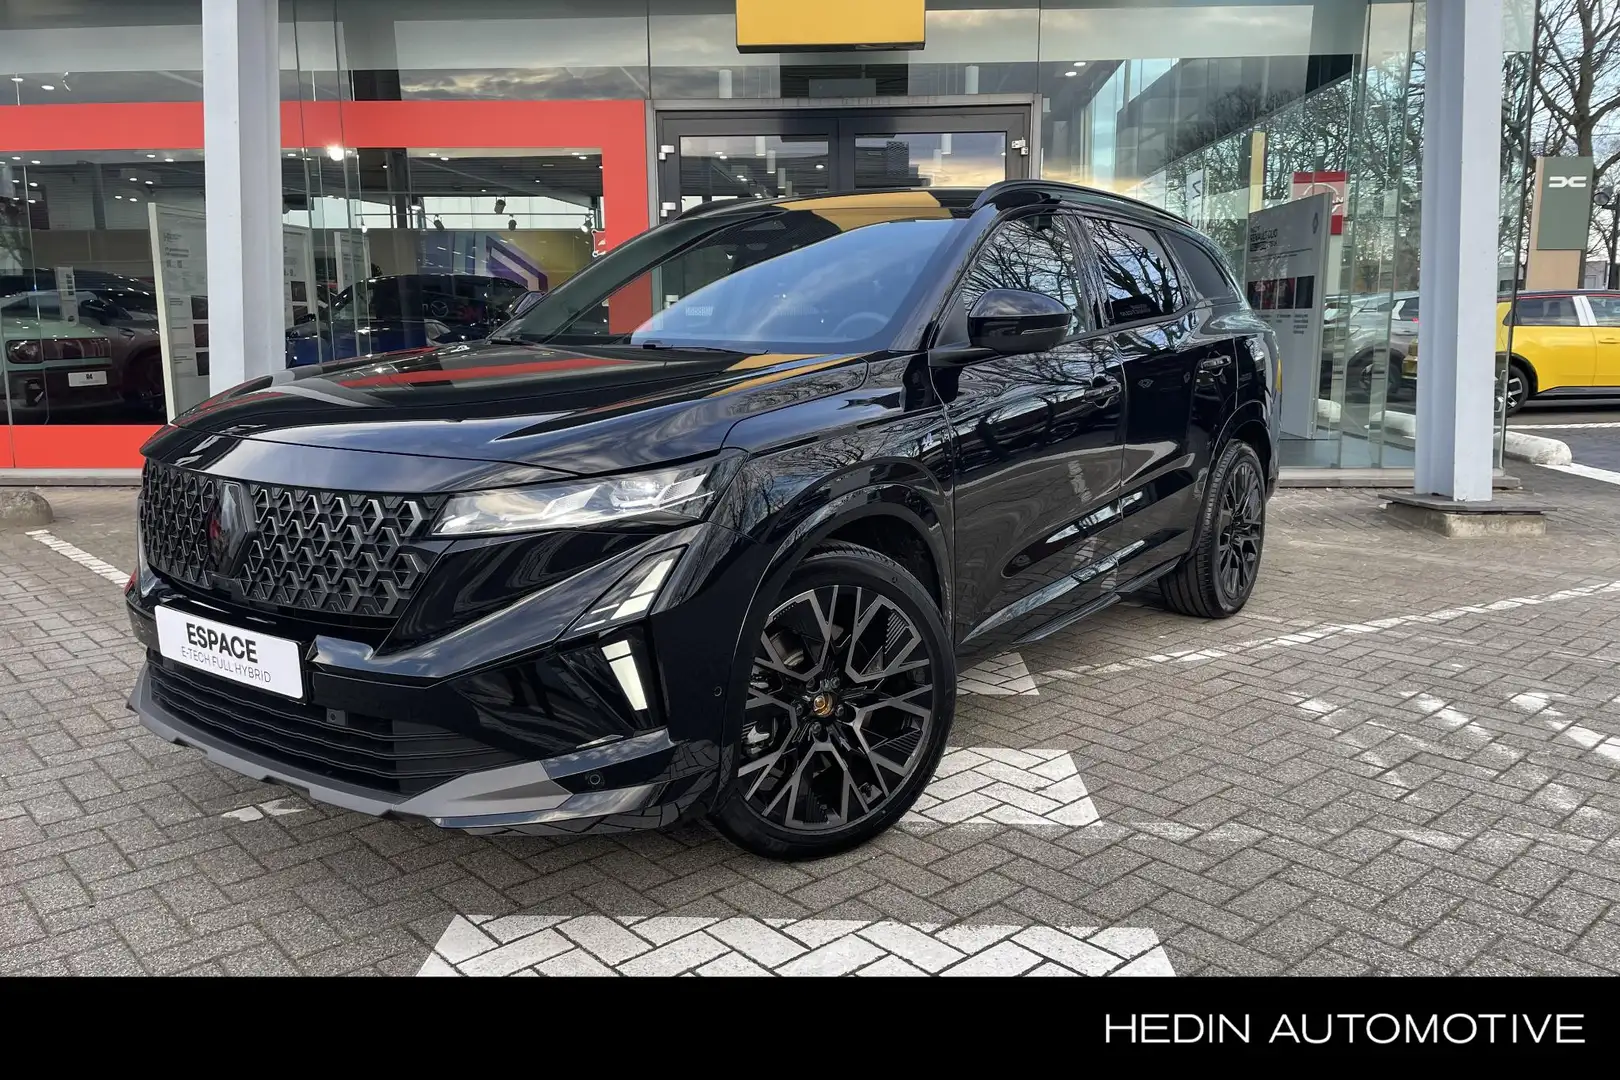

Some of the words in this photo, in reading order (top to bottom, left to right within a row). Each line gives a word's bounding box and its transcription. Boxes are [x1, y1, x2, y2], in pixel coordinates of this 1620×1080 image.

[186, 622, 258, 664] ESPACE
[181, 645, 211, 667] E-TECH
[212, 656, 233, 673] FULL
[235, 663, 271, 683] HYBRID
